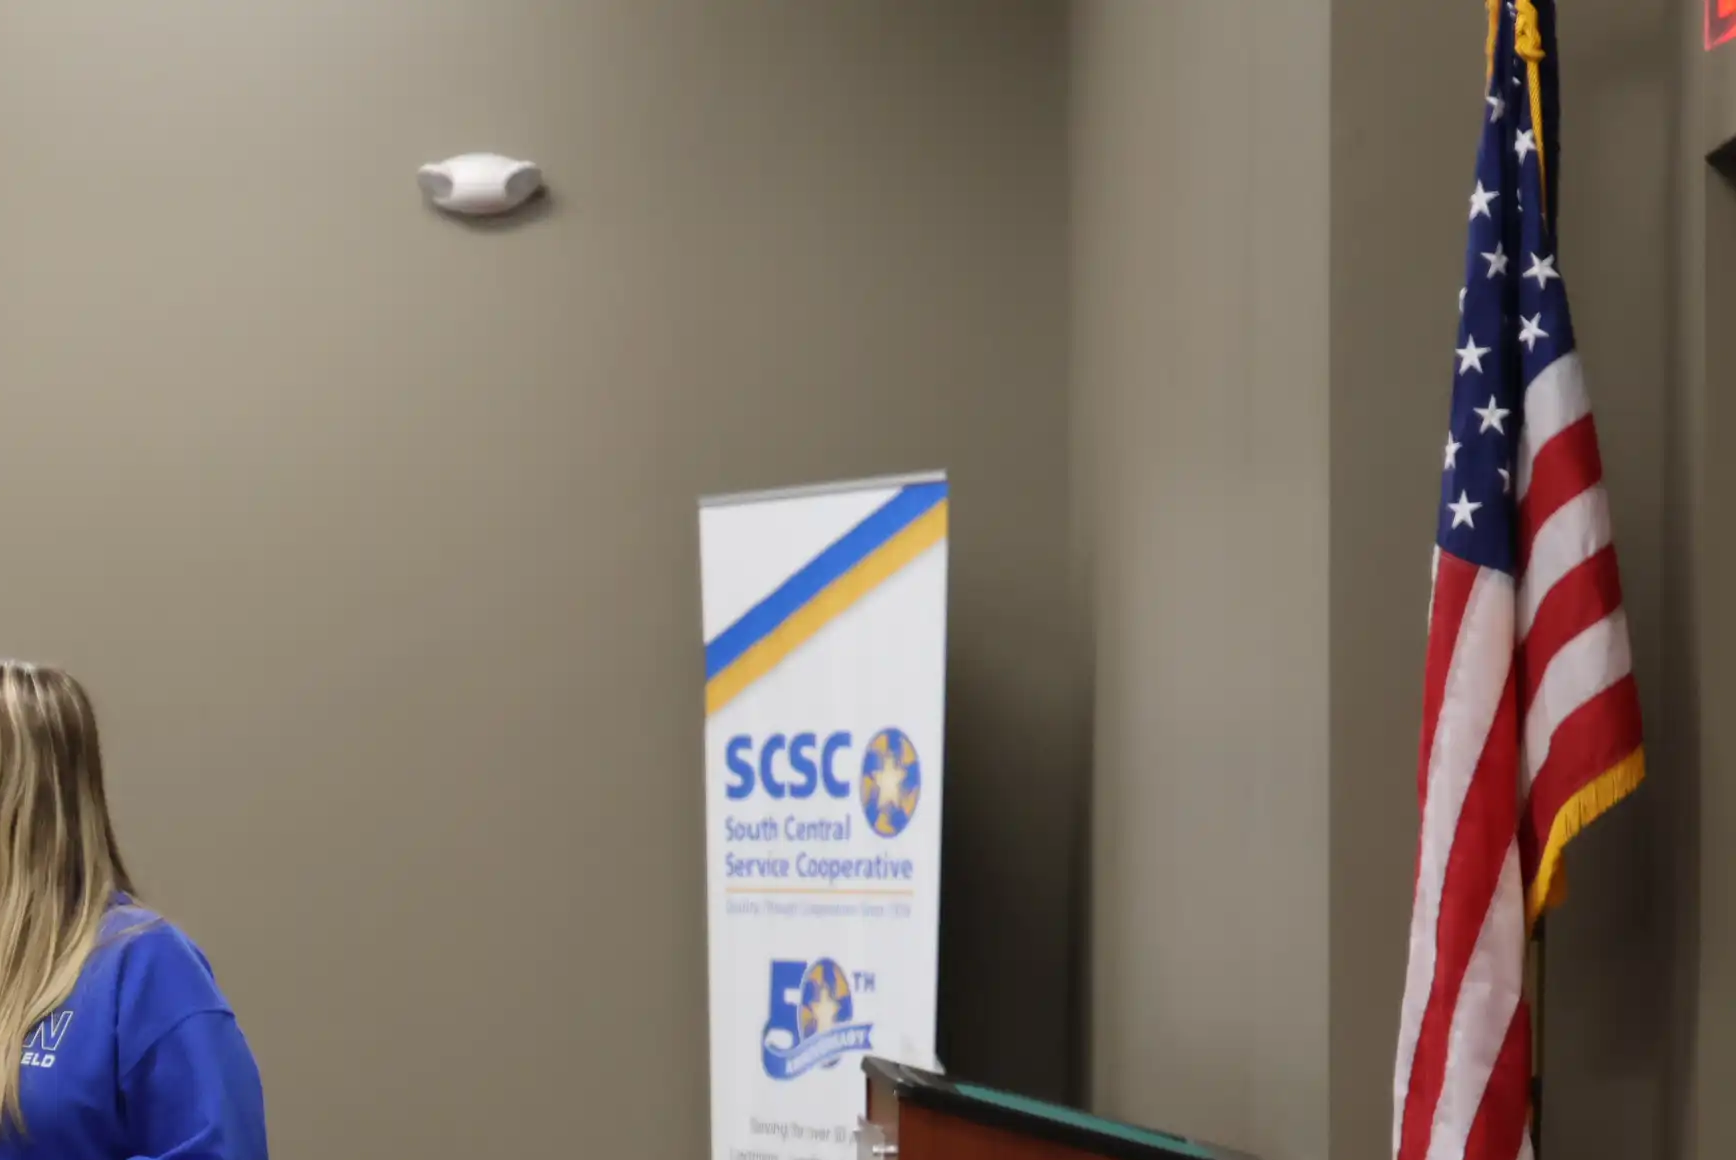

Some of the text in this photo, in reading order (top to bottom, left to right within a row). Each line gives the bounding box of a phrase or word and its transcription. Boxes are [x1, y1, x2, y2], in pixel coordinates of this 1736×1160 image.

[725, 731, 852, 801] SCSC
[725, 813, 851, 842] South Central
[725, 851, 913, 884] Service Cooperative
[20, 1052, 56, 1068] ELD
